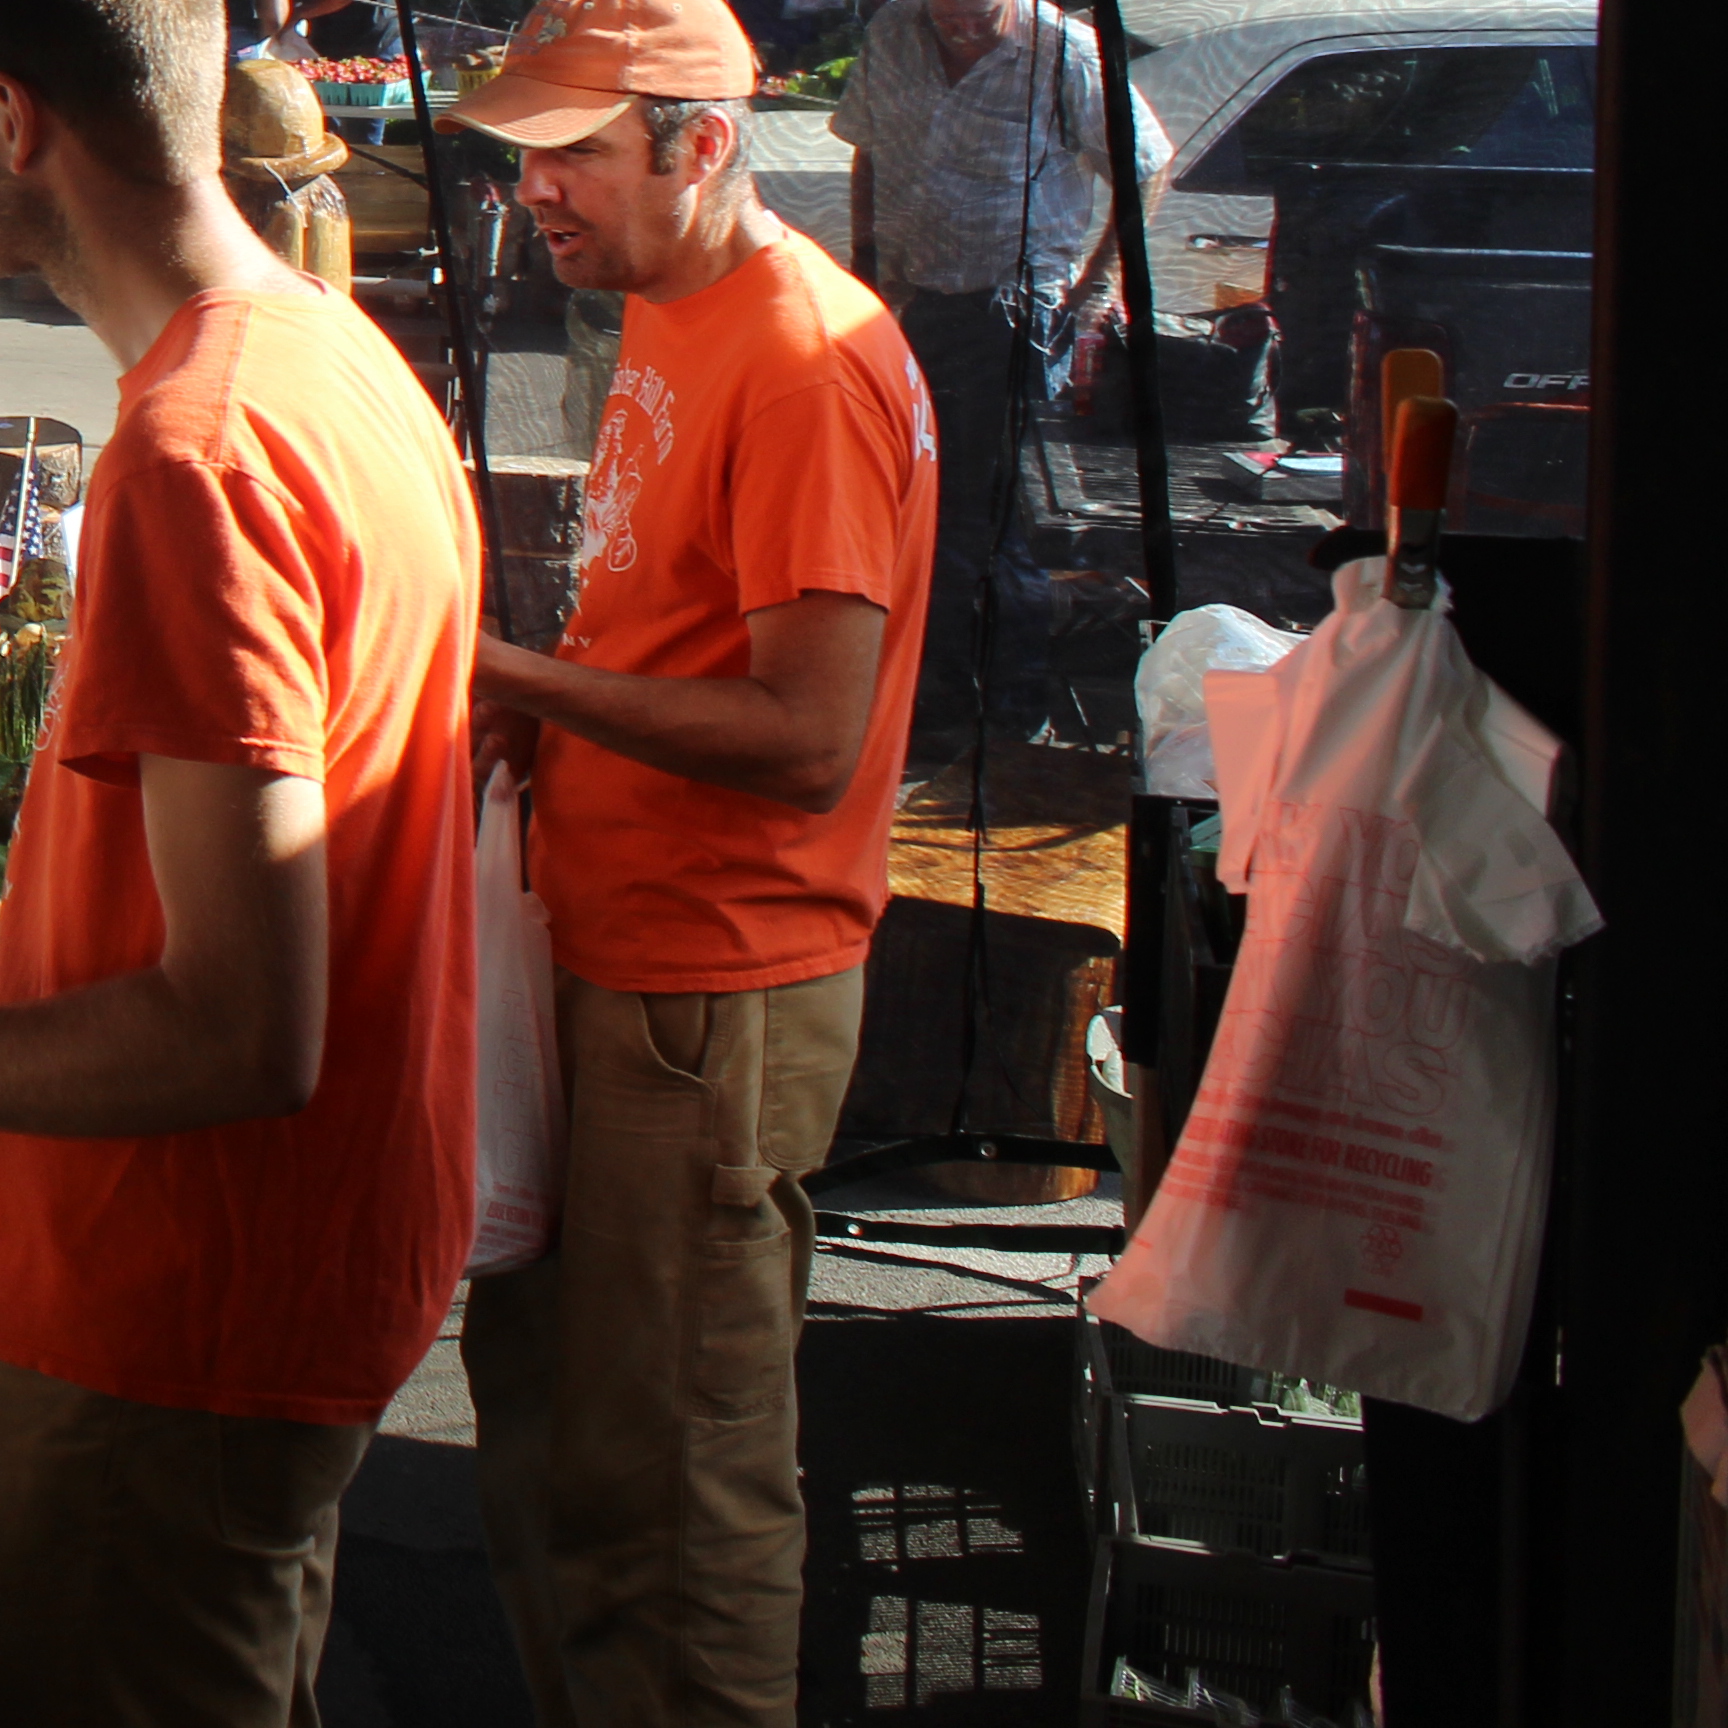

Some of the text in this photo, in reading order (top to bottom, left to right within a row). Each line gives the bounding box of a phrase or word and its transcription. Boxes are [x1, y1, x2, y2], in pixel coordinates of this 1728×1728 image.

[635, 366, 666, 416] Hill
[652, 390, 676, 465] Farm
[1257, 1122, 1434, 1188] STORE FOR RECYCLING
